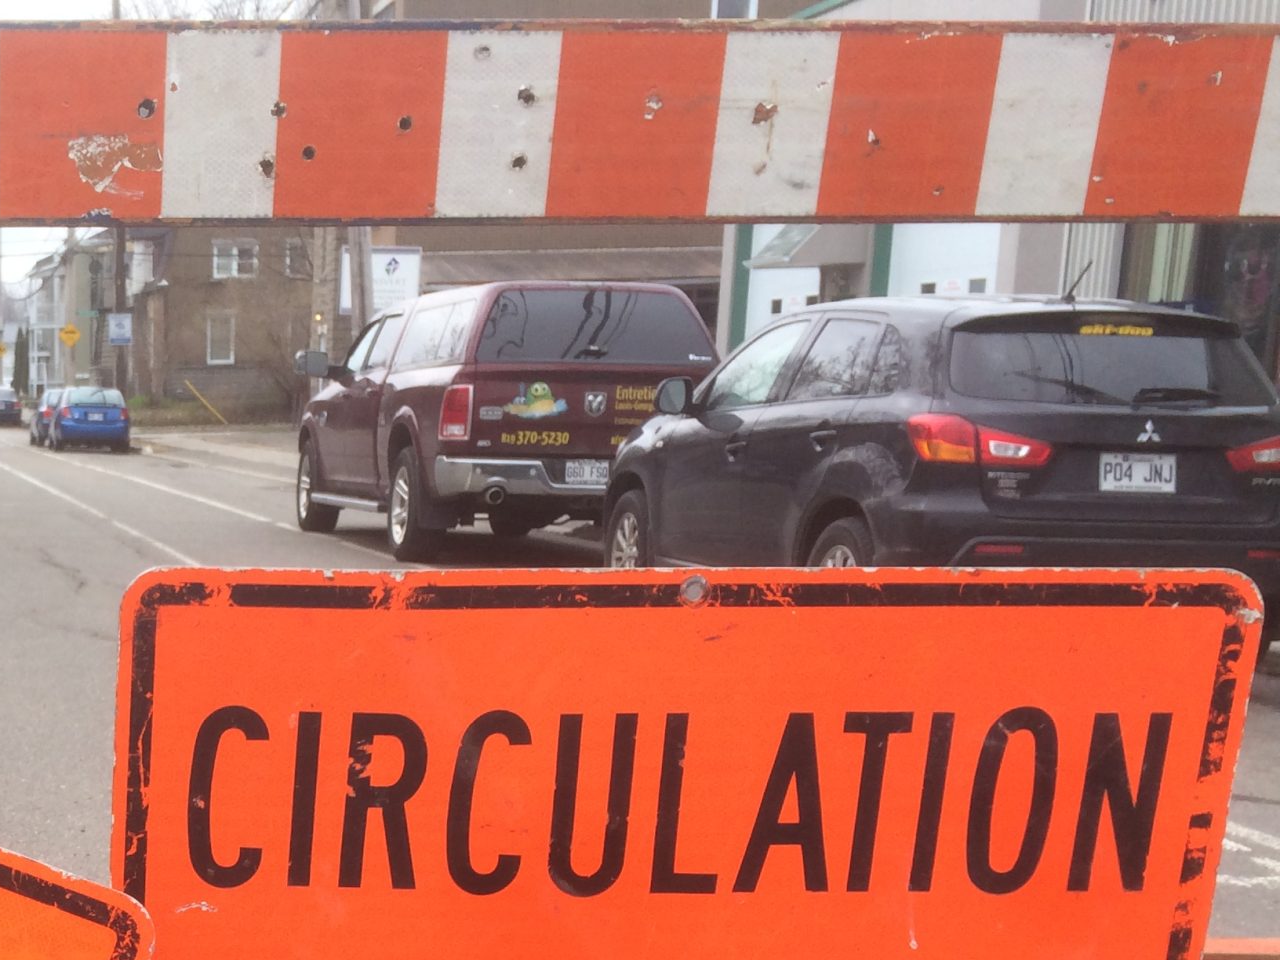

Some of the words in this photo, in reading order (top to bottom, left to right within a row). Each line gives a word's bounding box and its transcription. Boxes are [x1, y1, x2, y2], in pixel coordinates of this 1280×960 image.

[516, 431, 569, 446] 370-5230
[1104, 462, 1133, 482] P04
[1144, 463, 1173, 483] JNJ
[187, 705, 1172, 897] CIRCULATION
